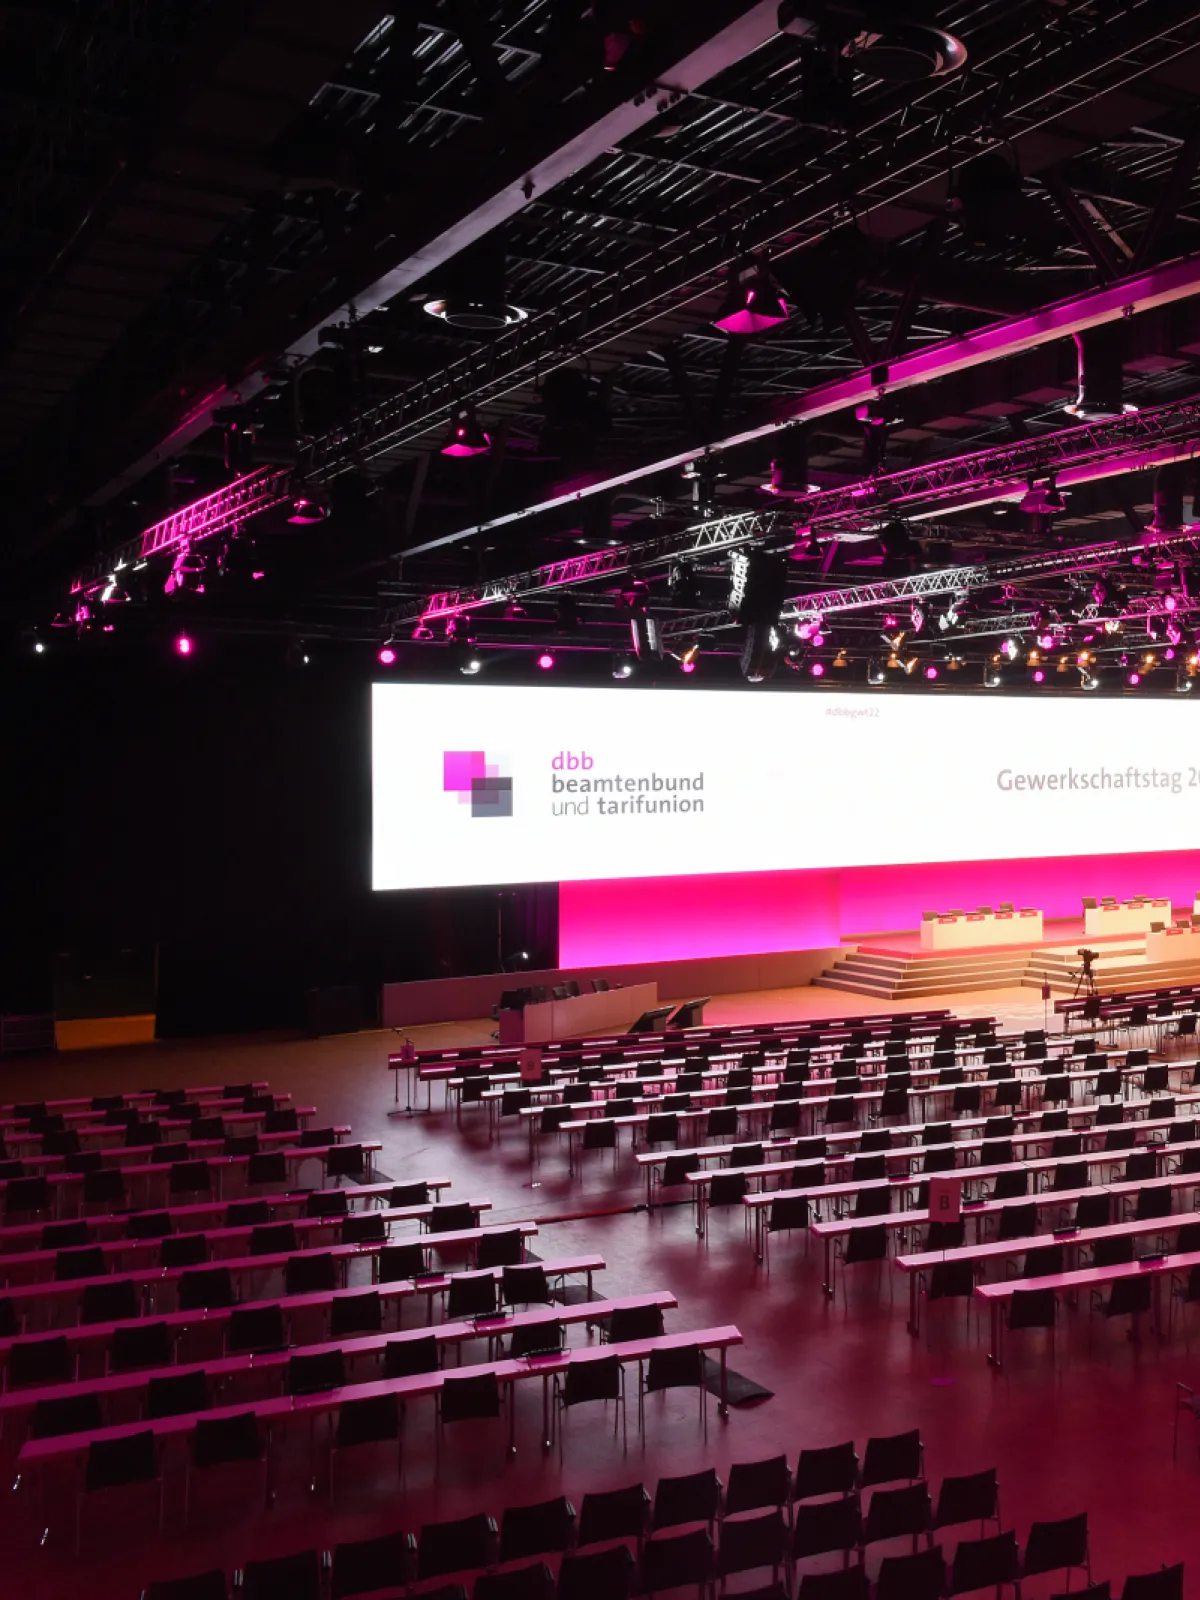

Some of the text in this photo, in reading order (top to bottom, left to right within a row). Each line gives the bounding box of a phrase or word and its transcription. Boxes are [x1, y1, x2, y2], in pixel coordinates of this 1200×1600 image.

[551, 750, 594, 771] dbb
[552, 771, 704, 793] beamtenbund
[996, 766, 1183, 794] Gewerkschaftstag
[551, 794, 704, 816] und tarifunion
[939, 1194, 950, 1210] B
